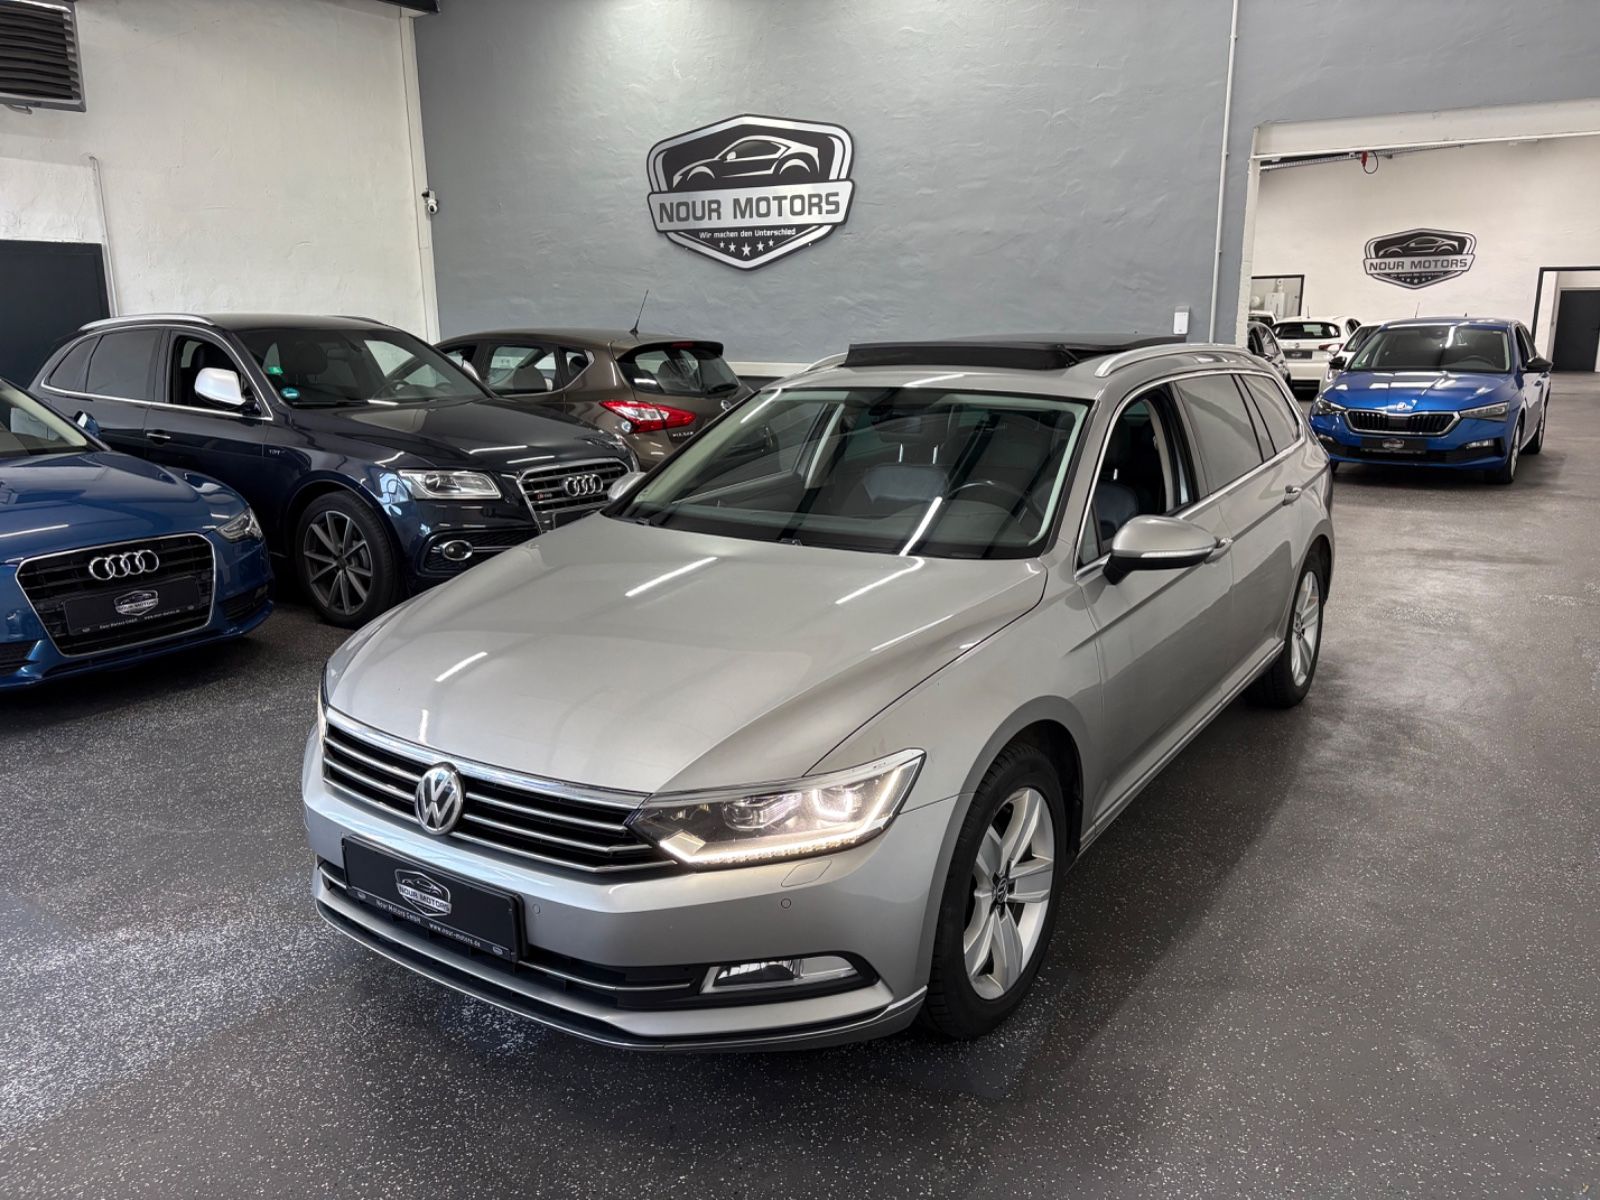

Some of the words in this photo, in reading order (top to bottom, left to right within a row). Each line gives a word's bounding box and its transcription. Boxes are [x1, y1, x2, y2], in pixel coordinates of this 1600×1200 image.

[659, 199, 722, 223] NOUR
[733, 192, 841, 220] MOTORS
[713, 230, 738, 238] machen
[740, 229, 753, 238] den
[754, 227, 797, 237] Unterschied
[1368, 260, 1405, 271] NOUR
[1410, 258, 1468, 270] MOTORS
[399, 886, 419, 900] NOUR
[420, 894, 450, 912] MOTORS
